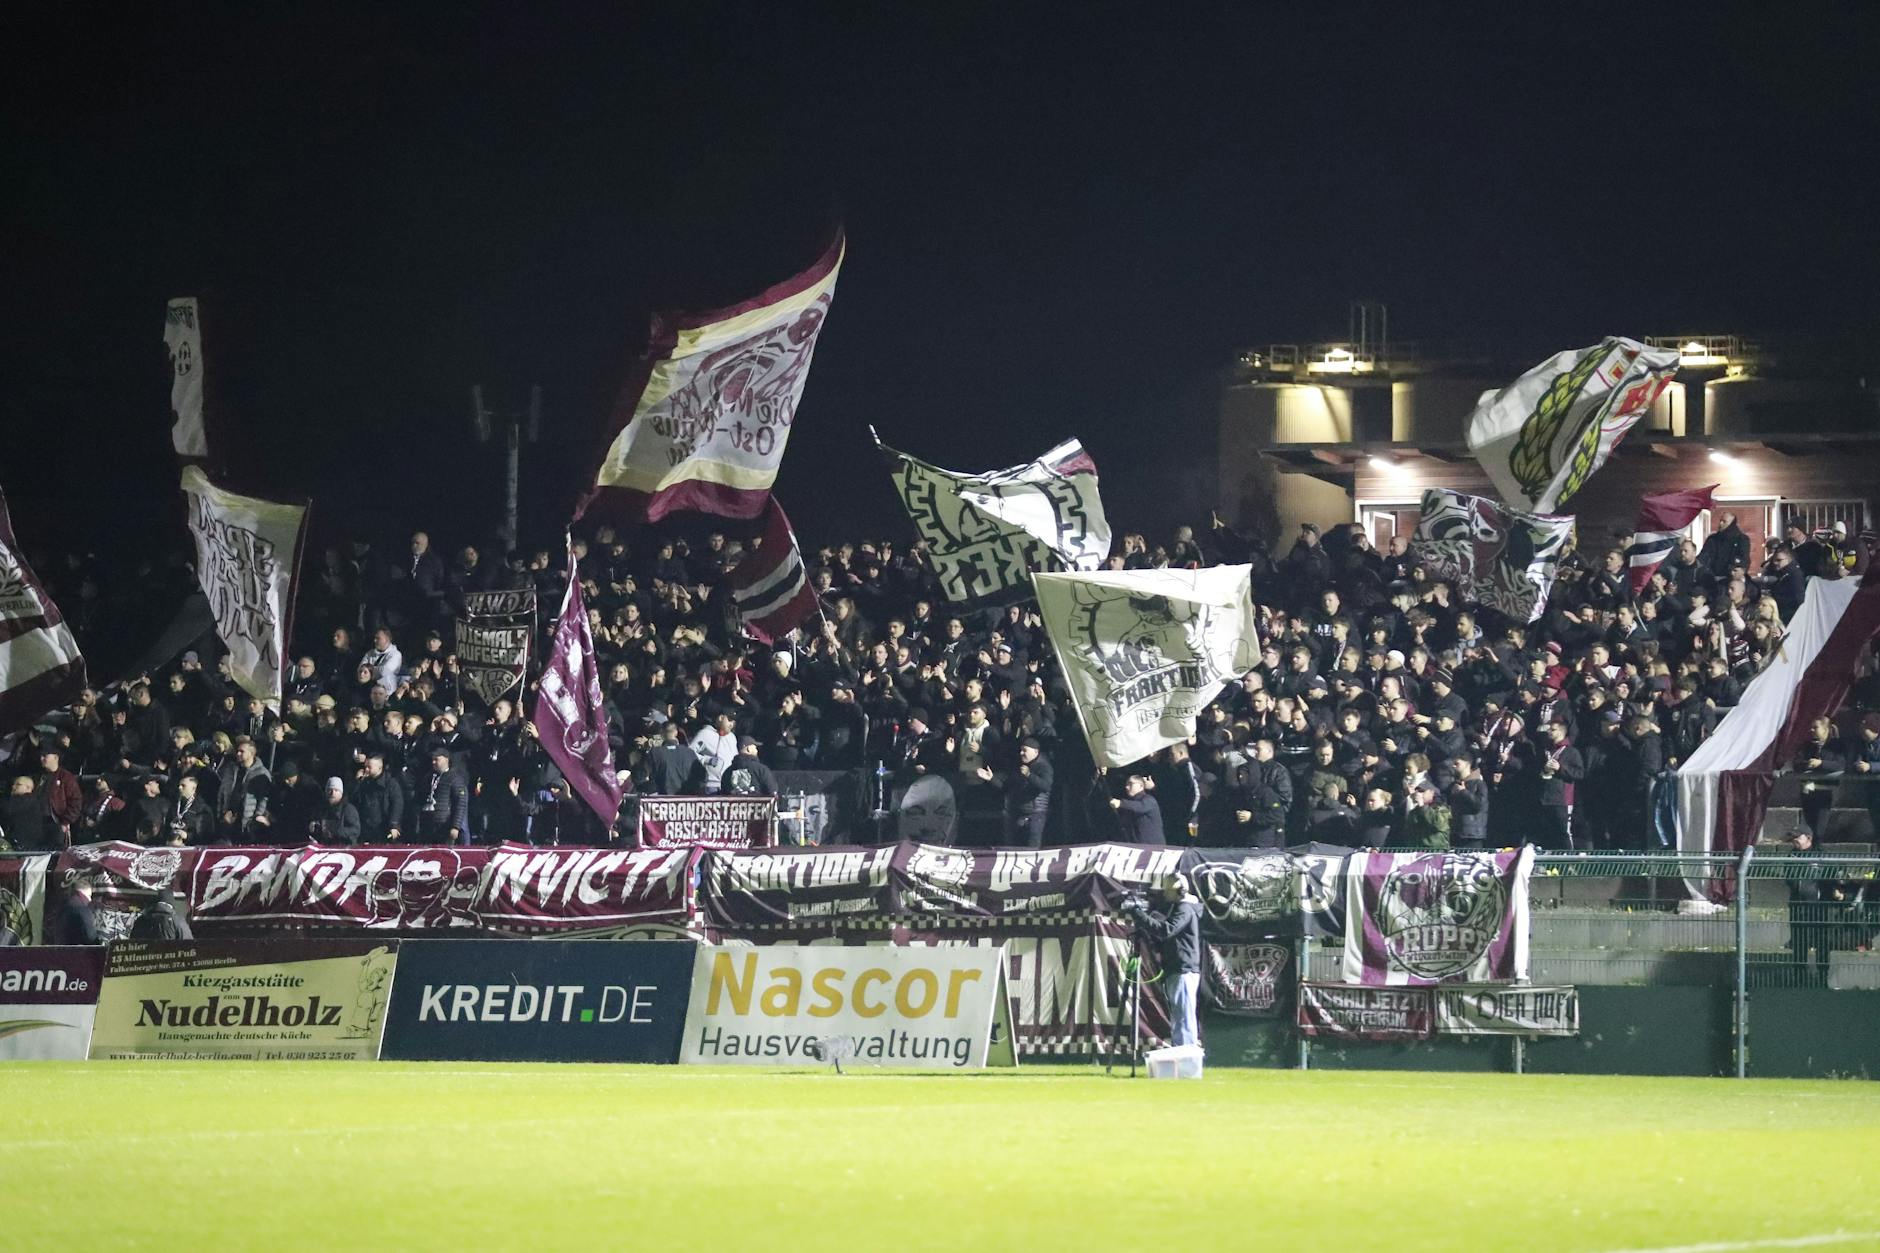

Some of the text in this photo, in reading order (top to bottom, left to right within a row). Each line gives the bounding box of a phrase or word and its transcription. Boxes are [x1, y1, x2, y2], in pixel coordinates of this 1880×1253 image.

[643, 801, 770, 821] VERBANDSSTRAFEN
[665, 820, 748, 840] ABSCHAFFEN
[196, 853, 389, 911] BANDA
[489, 850, 689, 910] INVICTA
[113, 942, 148, 953] Ab hier
[124, 953, 162, 963] Minuten
[183, 974, 304, 992] Kiezgaststätte
[704, 952, 982, 1019] Nascor
[134, 995, 343, 1028] Nudelholz
[418, 984, 658, 1023] KREDIT.DE
[158, 1031, 312, 1042] Hausgemachte deutsche Küche
[699, 1026, 972, 1067] Hausvewaltung
